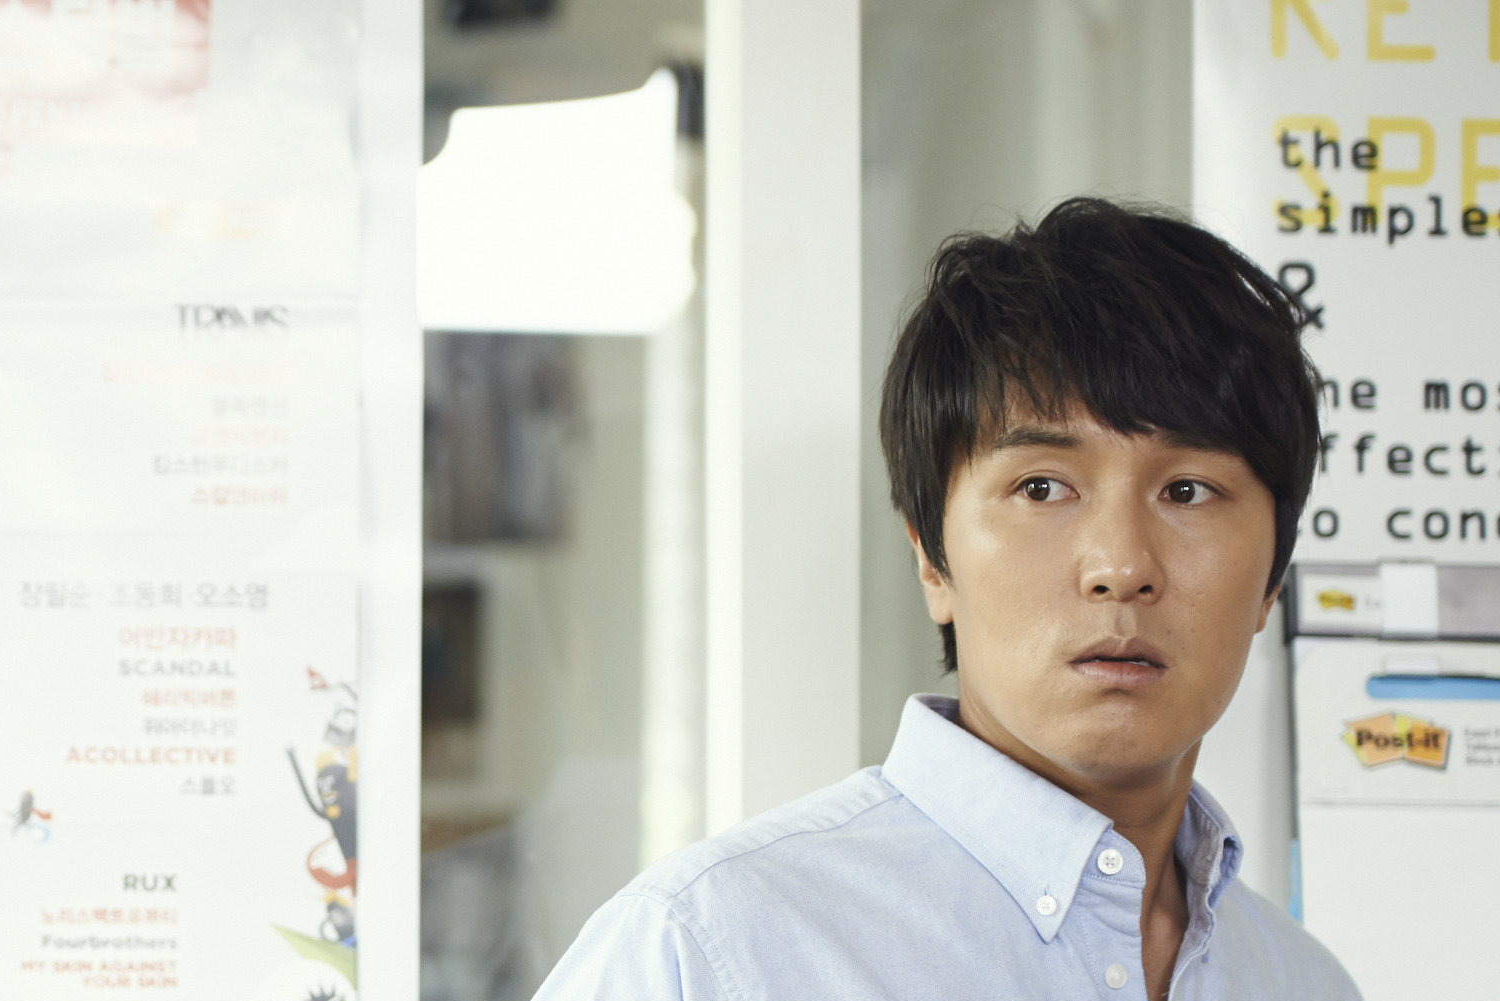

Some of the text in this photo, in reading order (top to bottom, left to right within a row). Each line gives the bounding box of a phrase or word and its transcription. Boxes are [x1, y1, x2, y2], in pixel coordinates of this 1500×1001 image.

[1279, 128, 1379, 171] the
[1278, 192, 1500, 245] simple
[1423, 379, 1500, 412] mo
[1317, 433, 1500, 476] ffect
[1386, 507, 1500, 541] con
[118, 658, 237, 678] SCANDAL
[1355, 727, 1441, 748] Post-it
[64, 746, 237, 766] ACOLLECTIVE
[122, 873, 178, 892] RUX
[41, 933, 177, 950] Fourbrothers
[20, 959, 178, 973] MY SKIN AGAINST
[82, 975, 179, 989] YOUR SKIN
